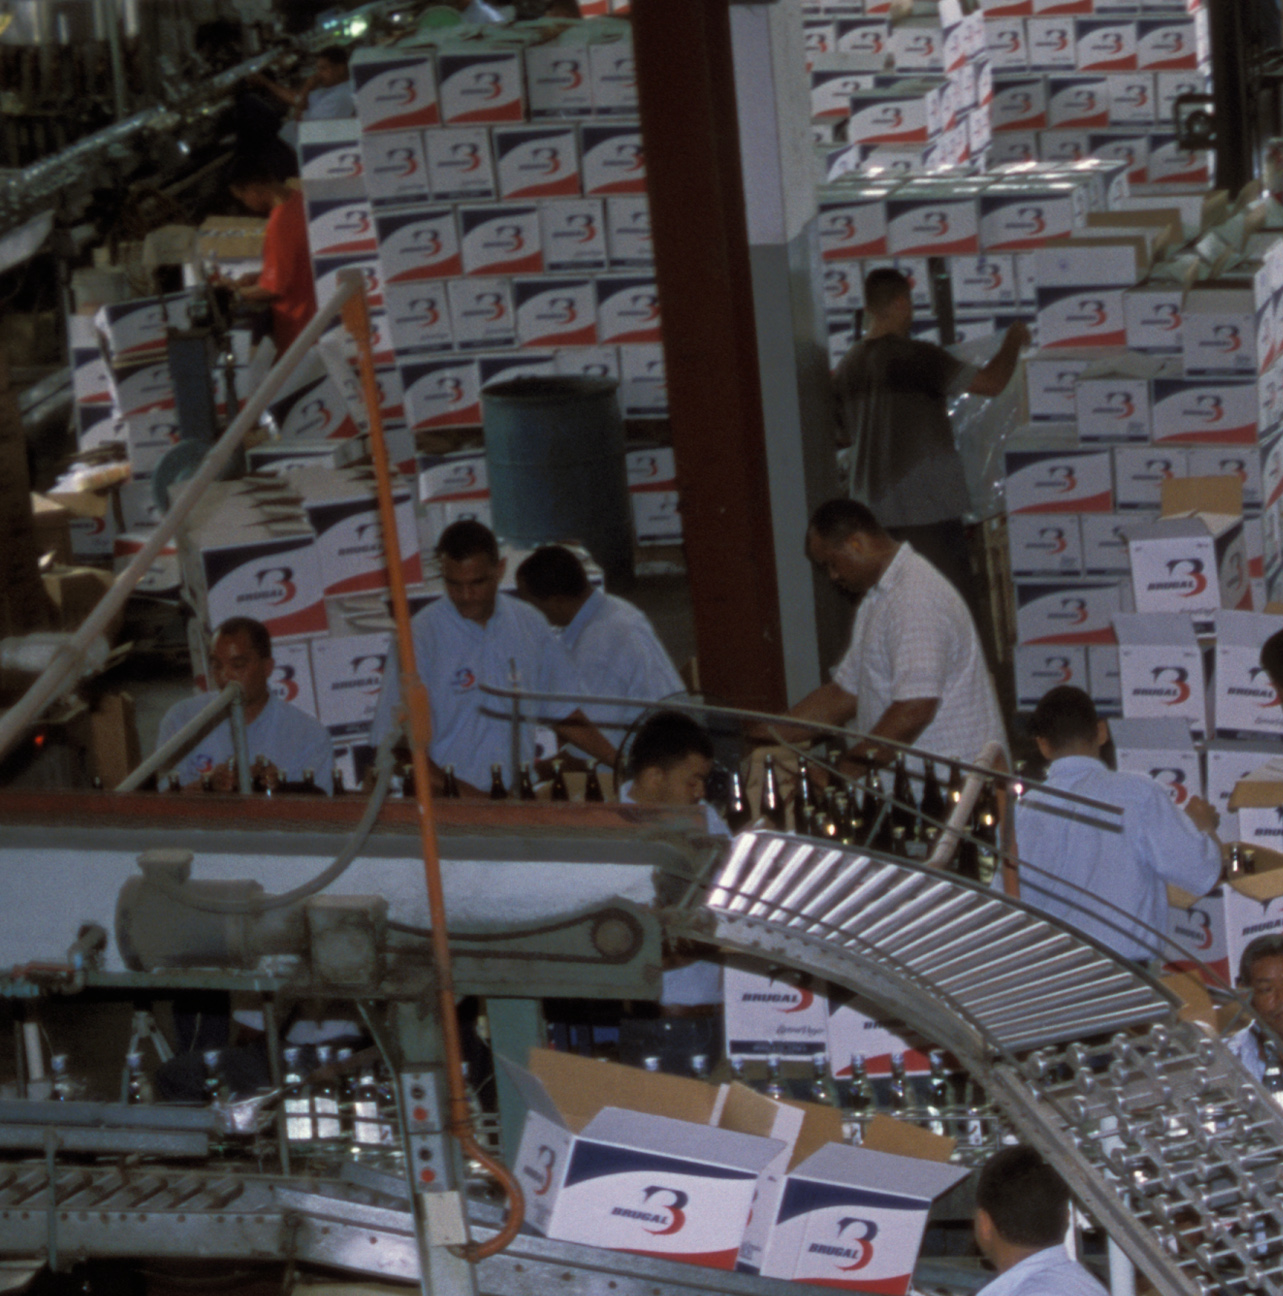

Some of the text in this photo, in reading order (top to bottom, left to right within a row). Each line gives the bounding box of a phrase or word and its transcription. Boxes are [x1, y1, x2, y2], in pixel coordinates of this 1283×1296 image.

[741, 991, 800, 1004] BRUGAL
[611, 1206, 669, 1224] BRUGAL
[808, 1242, 859, 1257] BRUGAL
